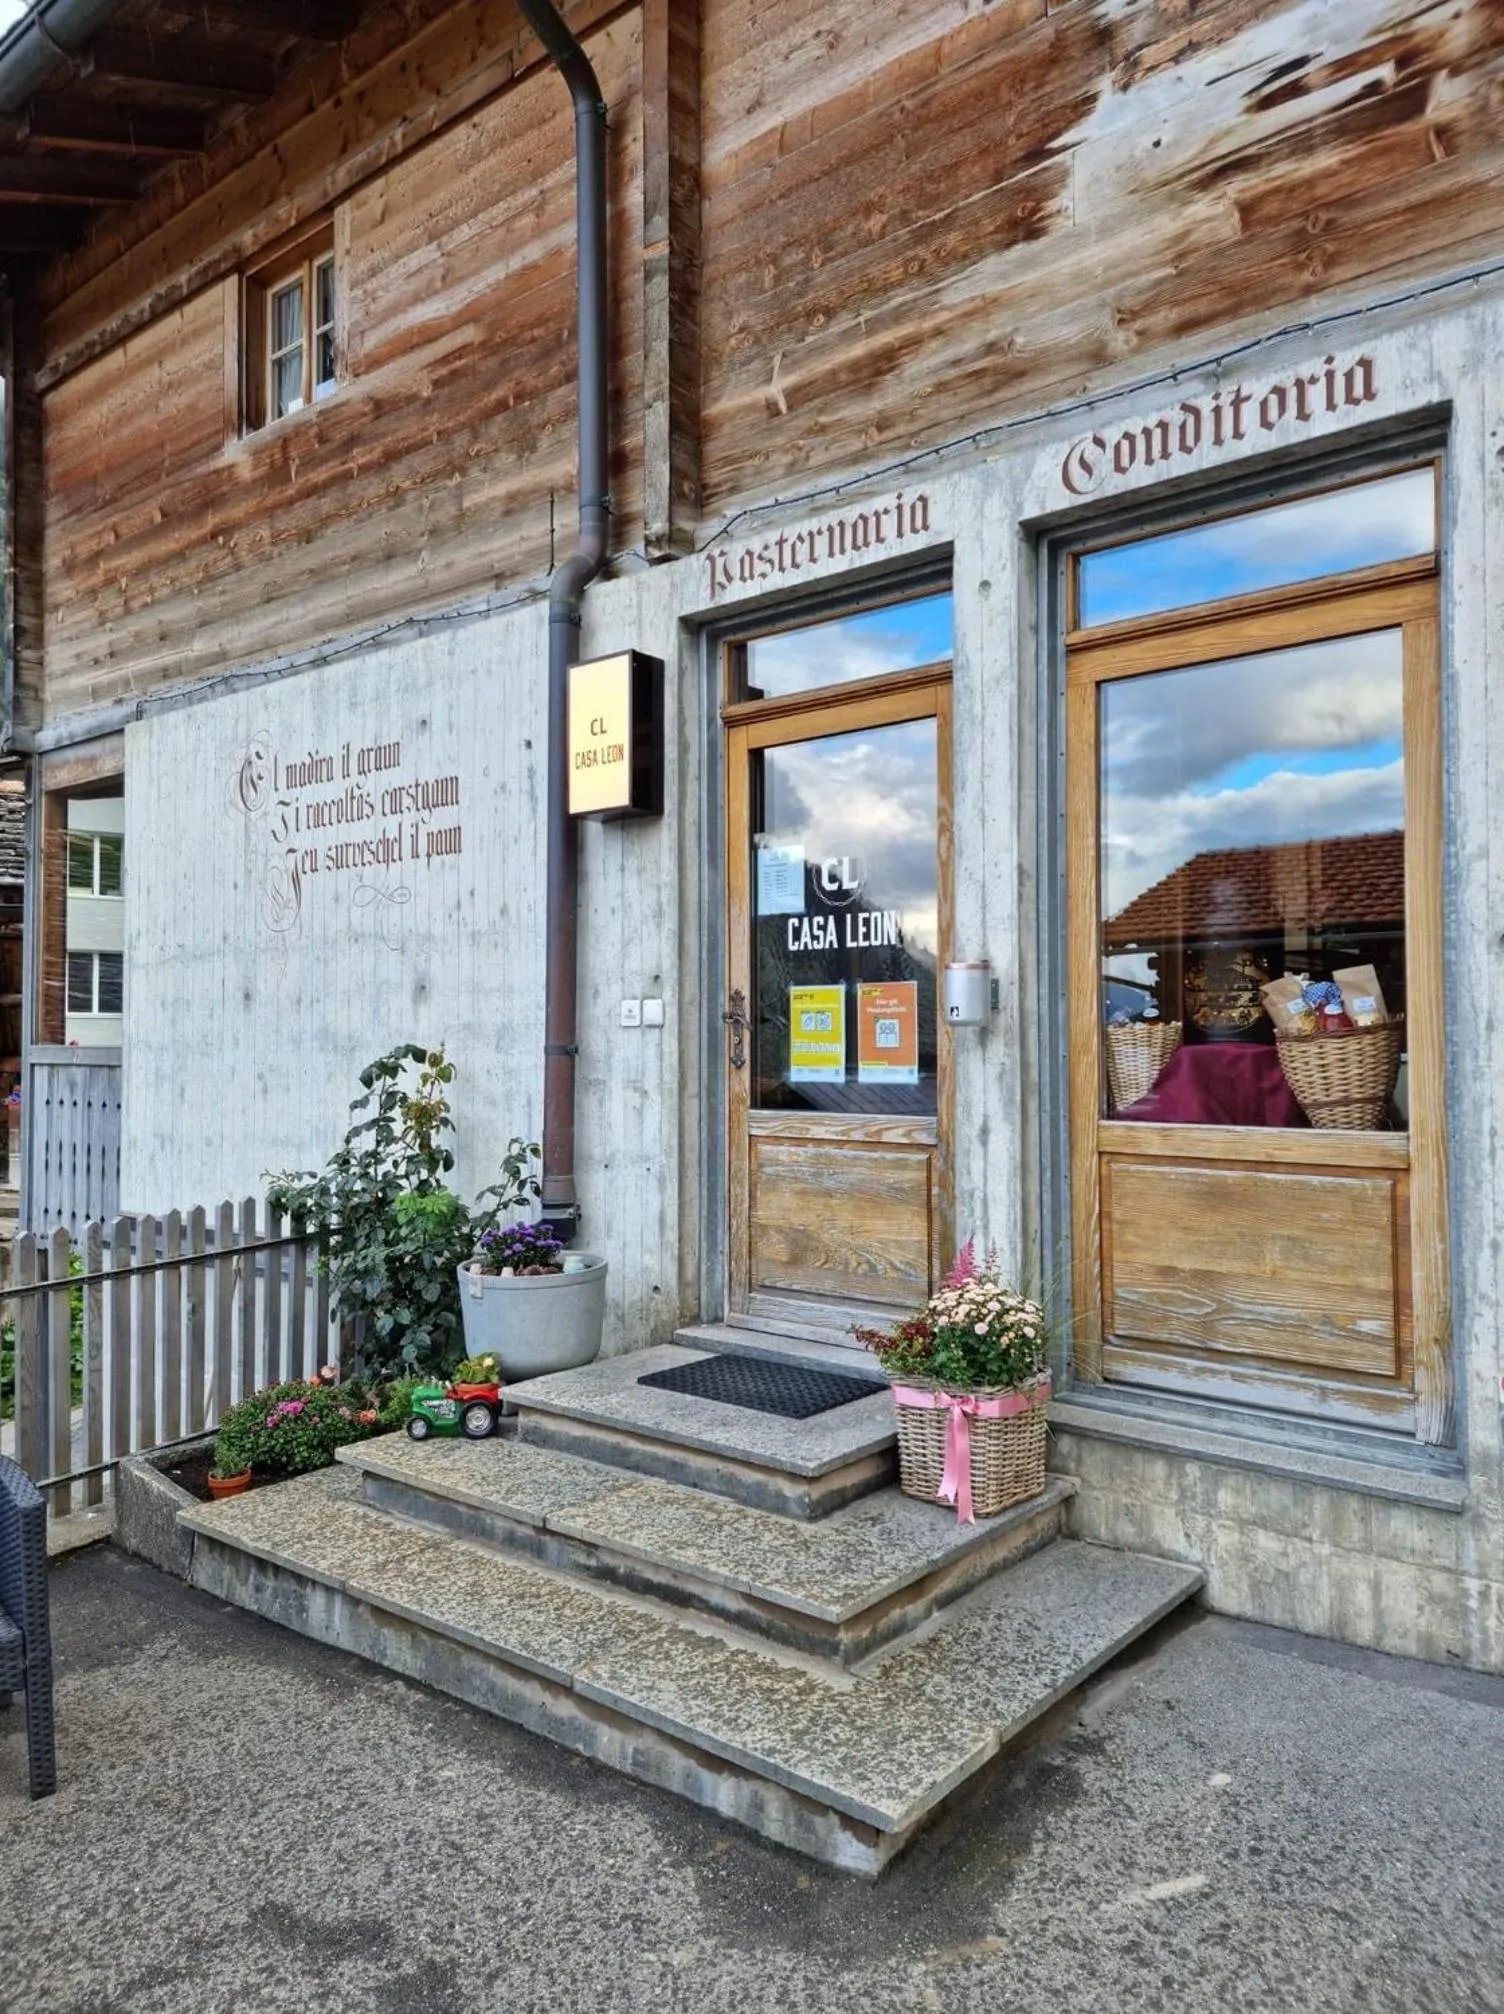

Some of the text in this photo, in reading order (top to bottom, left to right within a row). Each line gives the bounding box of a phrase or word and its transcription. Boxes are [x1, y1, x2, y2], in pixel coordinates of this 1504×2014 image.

[1061, 354, 1378, 495] Conditoria
[705, 491, 930, 601] Pasternaria
[590, 717, 608, 736] CL
[341, 742, 351, 780] il
[356, 740, 401, 790] graun
[575, 743, 625, 770] CASA LEON
[410, 822, 421, 859] il
[426, 825, 462, 871] paun
[821, 856, 859, 891] CL
[787, 910, 897, 950] CASA LEON
